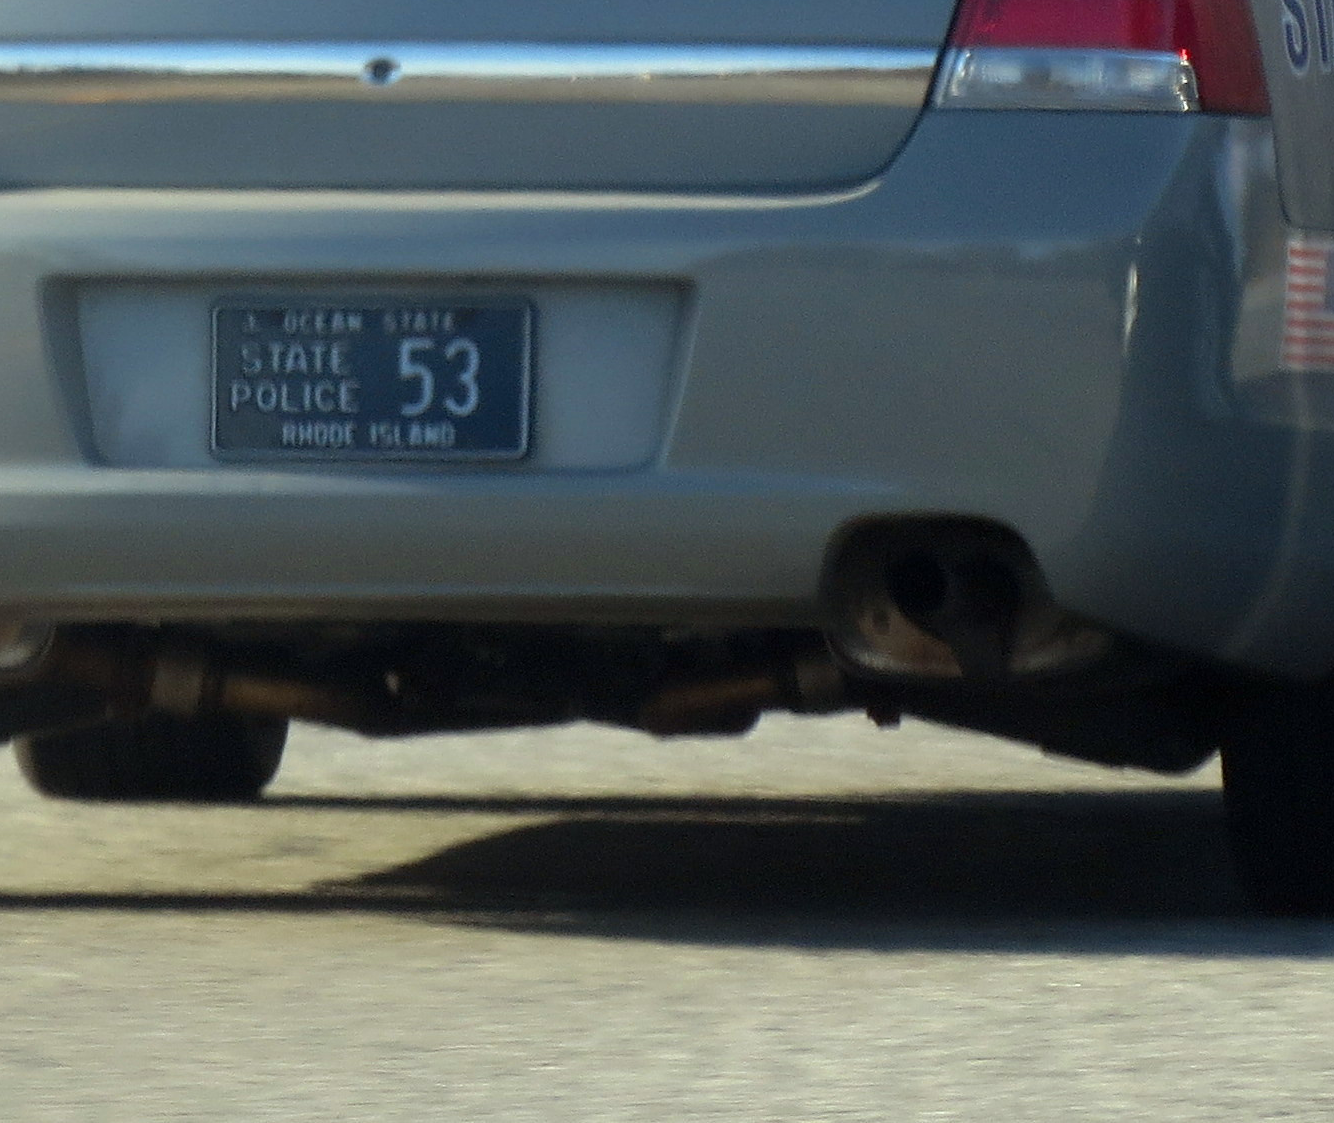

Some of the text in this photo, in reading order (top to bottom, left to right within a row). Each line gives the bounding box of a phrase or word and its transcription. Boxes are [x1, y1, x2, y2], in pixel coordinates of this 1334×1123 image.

[241, 340, 351, 373] STATE
[400, 336, 480, 417] 53
[229, 379, 361, 413] POLICE
